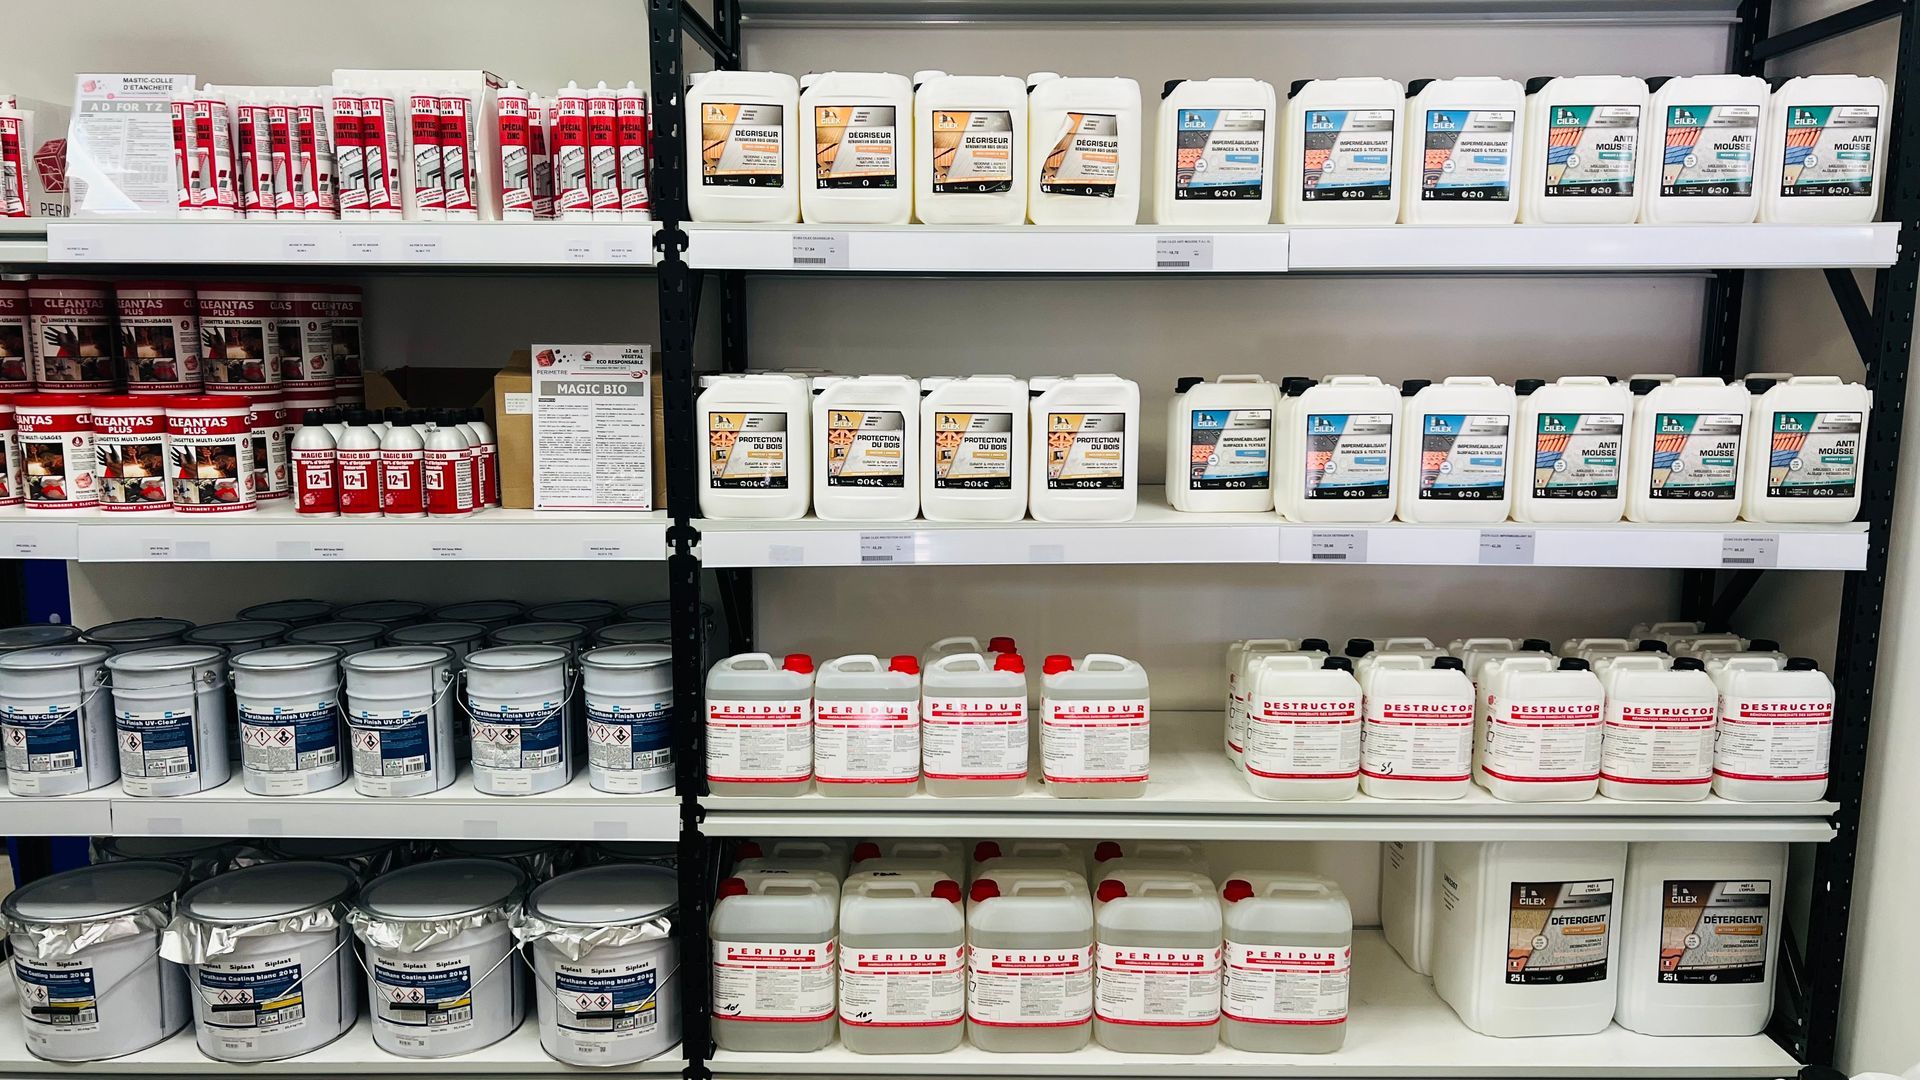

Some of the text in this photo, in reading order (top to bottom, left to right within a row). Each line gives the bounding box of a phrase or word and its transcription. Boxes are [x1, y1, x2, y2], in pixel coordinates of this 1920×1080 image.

[116, 103, 139, 111] FOR
[506, 101, 519, 109] FOR
[563, 101, 576, 109] FOR
[594, 101, 607, 109] FOR
[623, 101, 636, 109] FOR
[735, 128, 778, 138] DÉGRISEUR
[849, 130, 891, 139] DÉGRISEUR
[966, 135, 1008, 144] DÉGRISEUR
[1613, 135, 1633, 143] ANTI
[1732, 135, 1752, 143] ANTI
[1852, 135, 1872, 143] ANTI
[1596, 143, 1632, 151] MOUSSE
[1713, 143, 1750, 151] MOUSSE
[1834, 143, 1871, 151] MOUSSE
[558, 384, 627, 394] MAGIC BIO
[94, 417, 153, 426] CLEANTAS
[169, 418, 228, 427] CLEANTAS
[1430, 425, 1451, 433] CILEX
[1598, 441, 1617, 449] ANTI
[1717, 442, 1735, 450] ANTI
[1582, 449, 1616, 457] MOUSSE
[1700, 449, 1734, 457] MOUSSE
[711, 705, 801, 713] PERIDUR
[818, 706, 908, 714] PERIDUR
[932, 702, 1022, 711] PERIDUR
[1054, 704, 1144, 713] PERIDUR
[1263, 701, 1355, 710] DESTRUCTOR
[1384, 703, 1473, 712] DESTRUCTOR
[1511, 704, 1600, 714] DESTRUCTOR
[1740, 702, 1832, 712] DESTRUCTOR
[1623, 706, 1715, 716] DESTRUCTOR
[1519, 897, 1546, 905] CILEX
[1672, 896, 1697, 904] CILEX
[1551, 913, 1606, 926] DÉTERGENT
[1704, 914, 1763, 924] DÉTERGENT
[727, 947, 816, 956] PERIDUR
[1115, 951, 1204, 961] PERIDUR
[1246, 950, 1335, 960] PERIDUR
[991, 953, 1079, 962] PERIDUR
[265, 958, 291, 967] Siplast
[436, 959, 461, 968] Siplast
[625, 962, 649, 972] Siplast
[561, 965, 582, 973] Siplast
[1510, 974, 1520, 983] 25
[1663, 973, 1672, 981] 25
